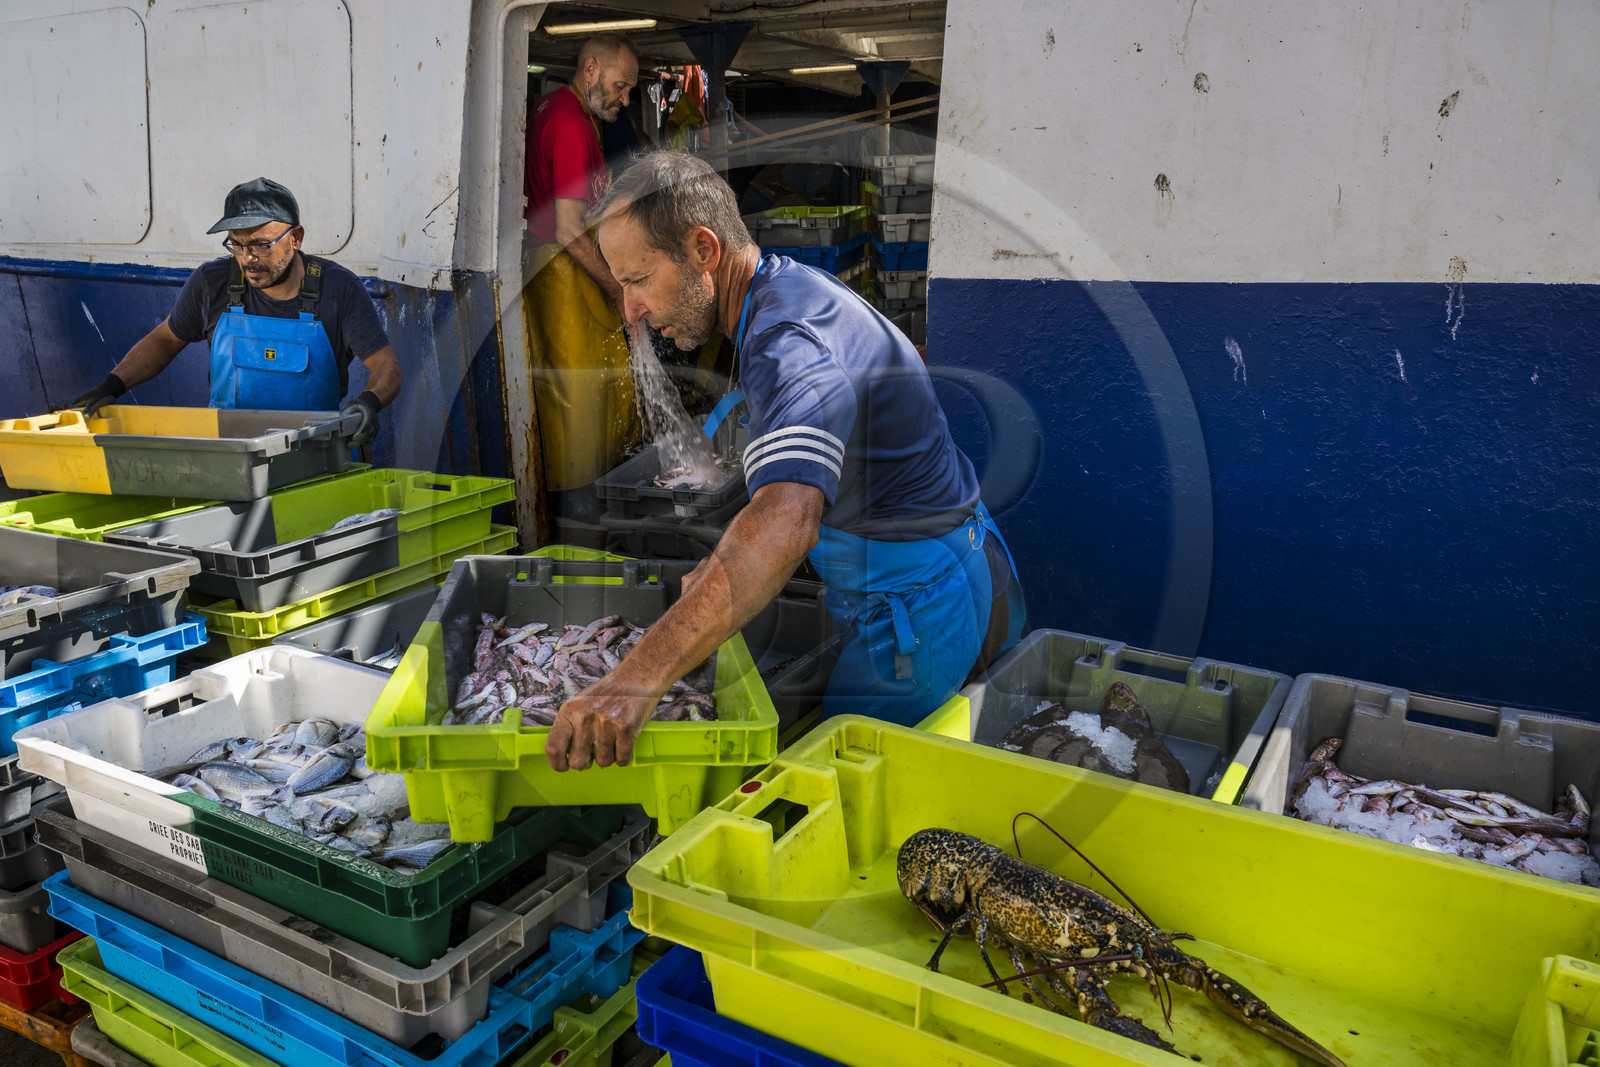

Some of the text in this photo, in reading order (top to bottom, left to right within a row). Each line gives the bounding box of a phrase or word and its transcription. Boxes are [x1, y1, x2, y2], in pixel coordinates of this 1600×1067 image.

[148, 820, 170, 839] CRIEE
[170, 828, 185, 845] DES
[169, 842, 210, 868] PROPRIETE
[226, 865, 254, 887] VENDEE
